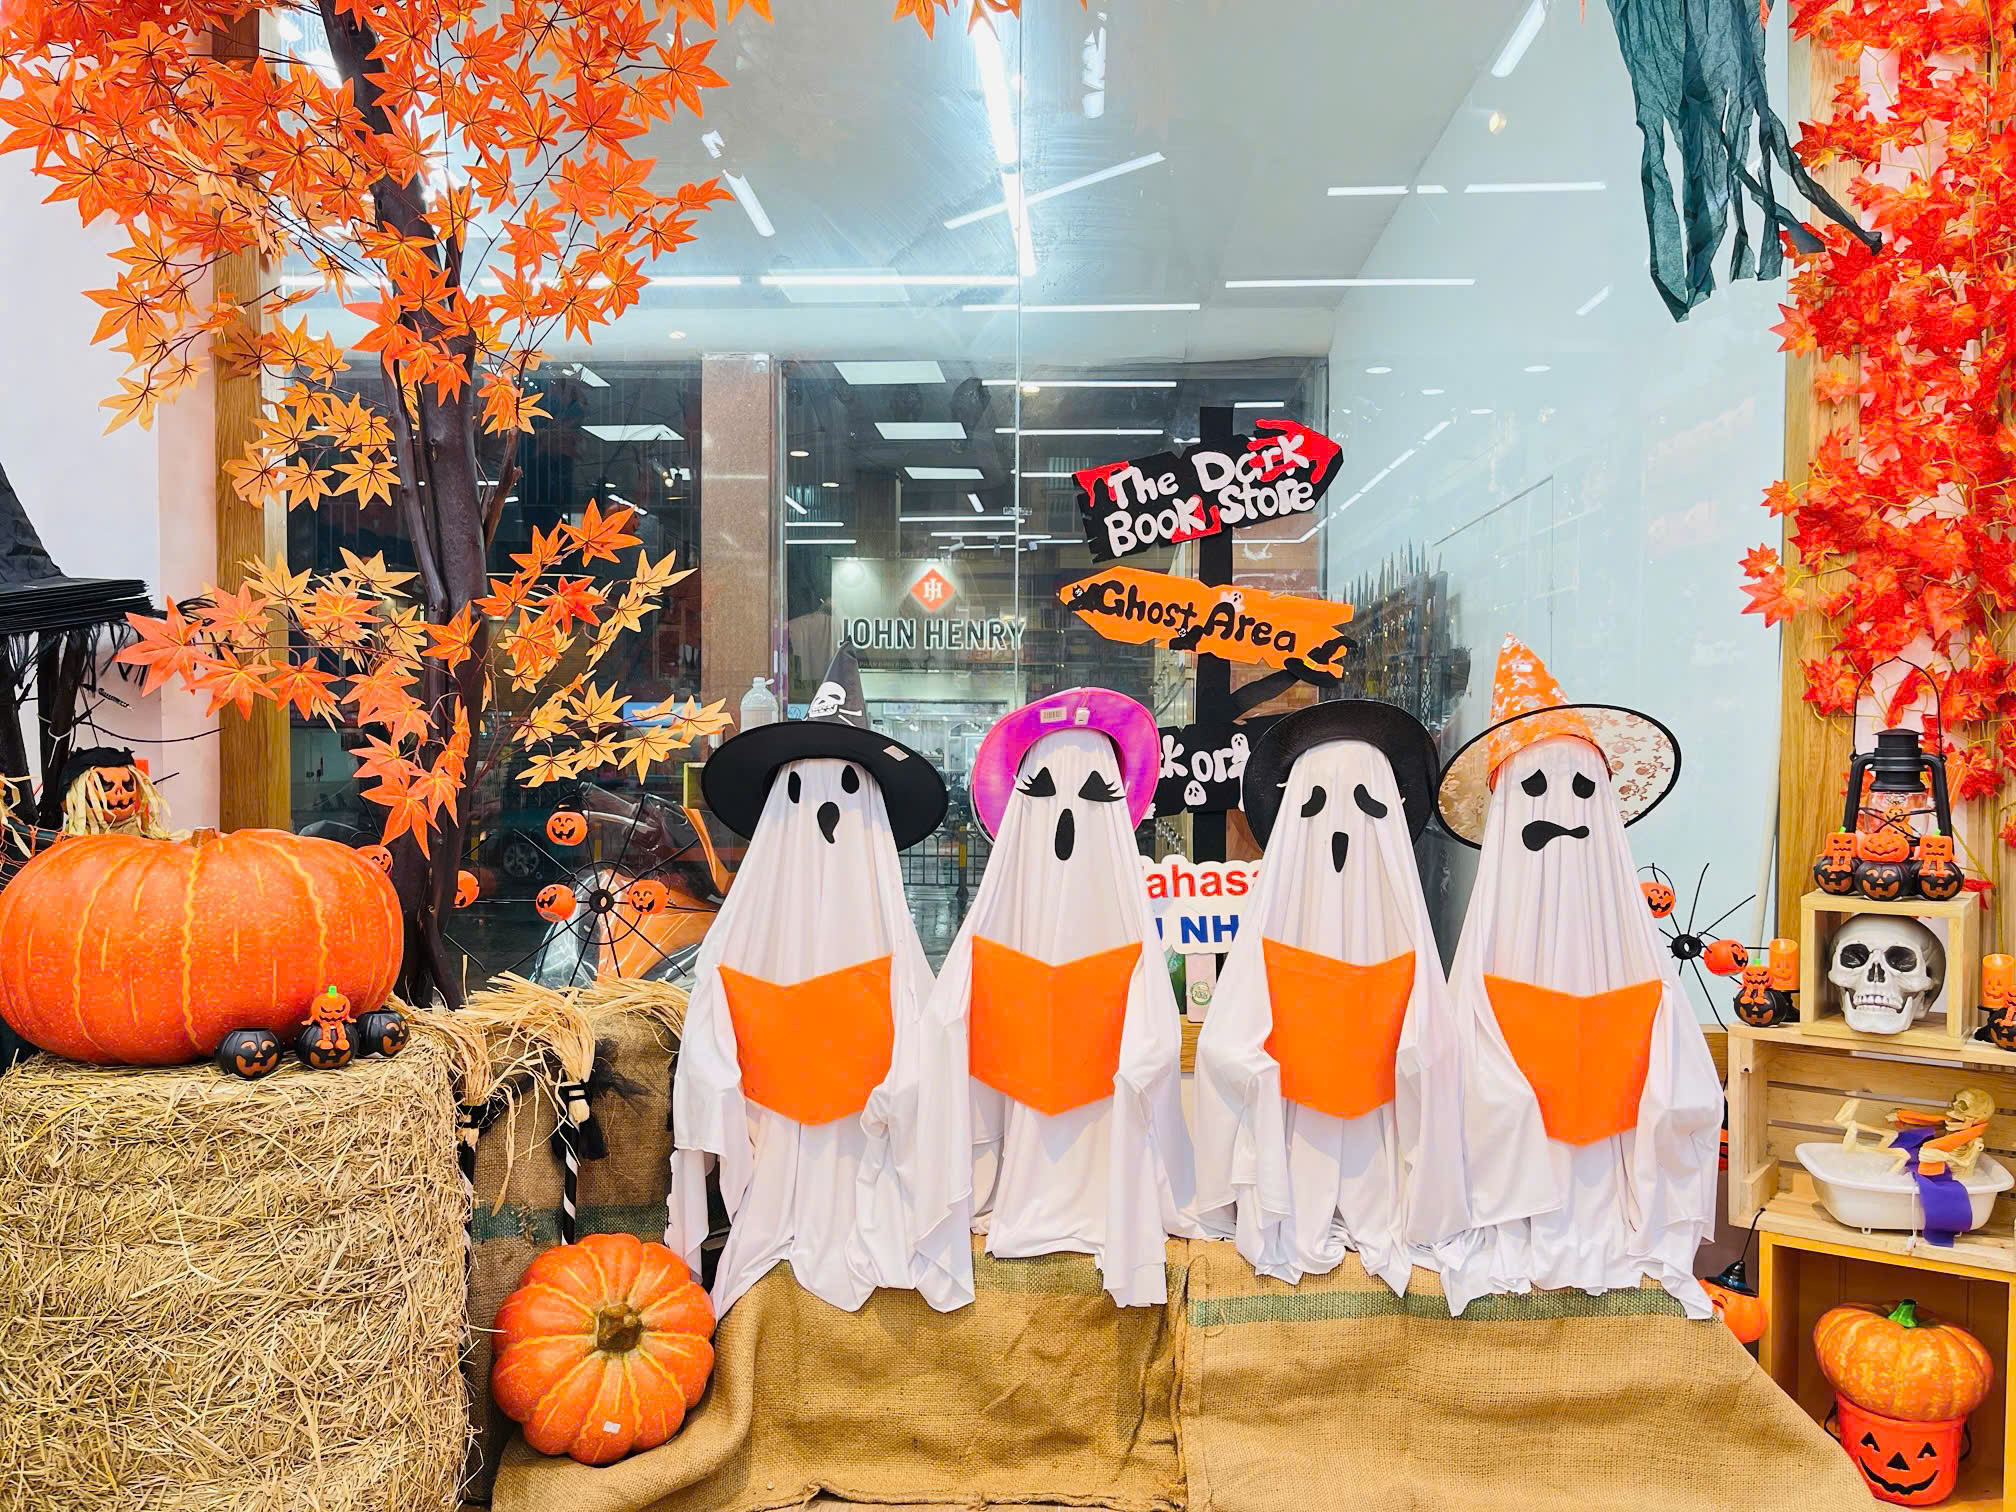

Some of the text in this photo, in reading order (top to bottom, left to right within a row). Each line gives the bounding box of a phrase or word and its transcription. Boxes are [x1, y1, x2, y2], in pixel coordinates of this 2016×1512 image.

[1108, 465, 1180, 510] The
[839, 618, 1026, 649] JOHN HENRY
[1099, 580, 1297, 653] Ghost Area
[1191, 747, 1234, 783] or
